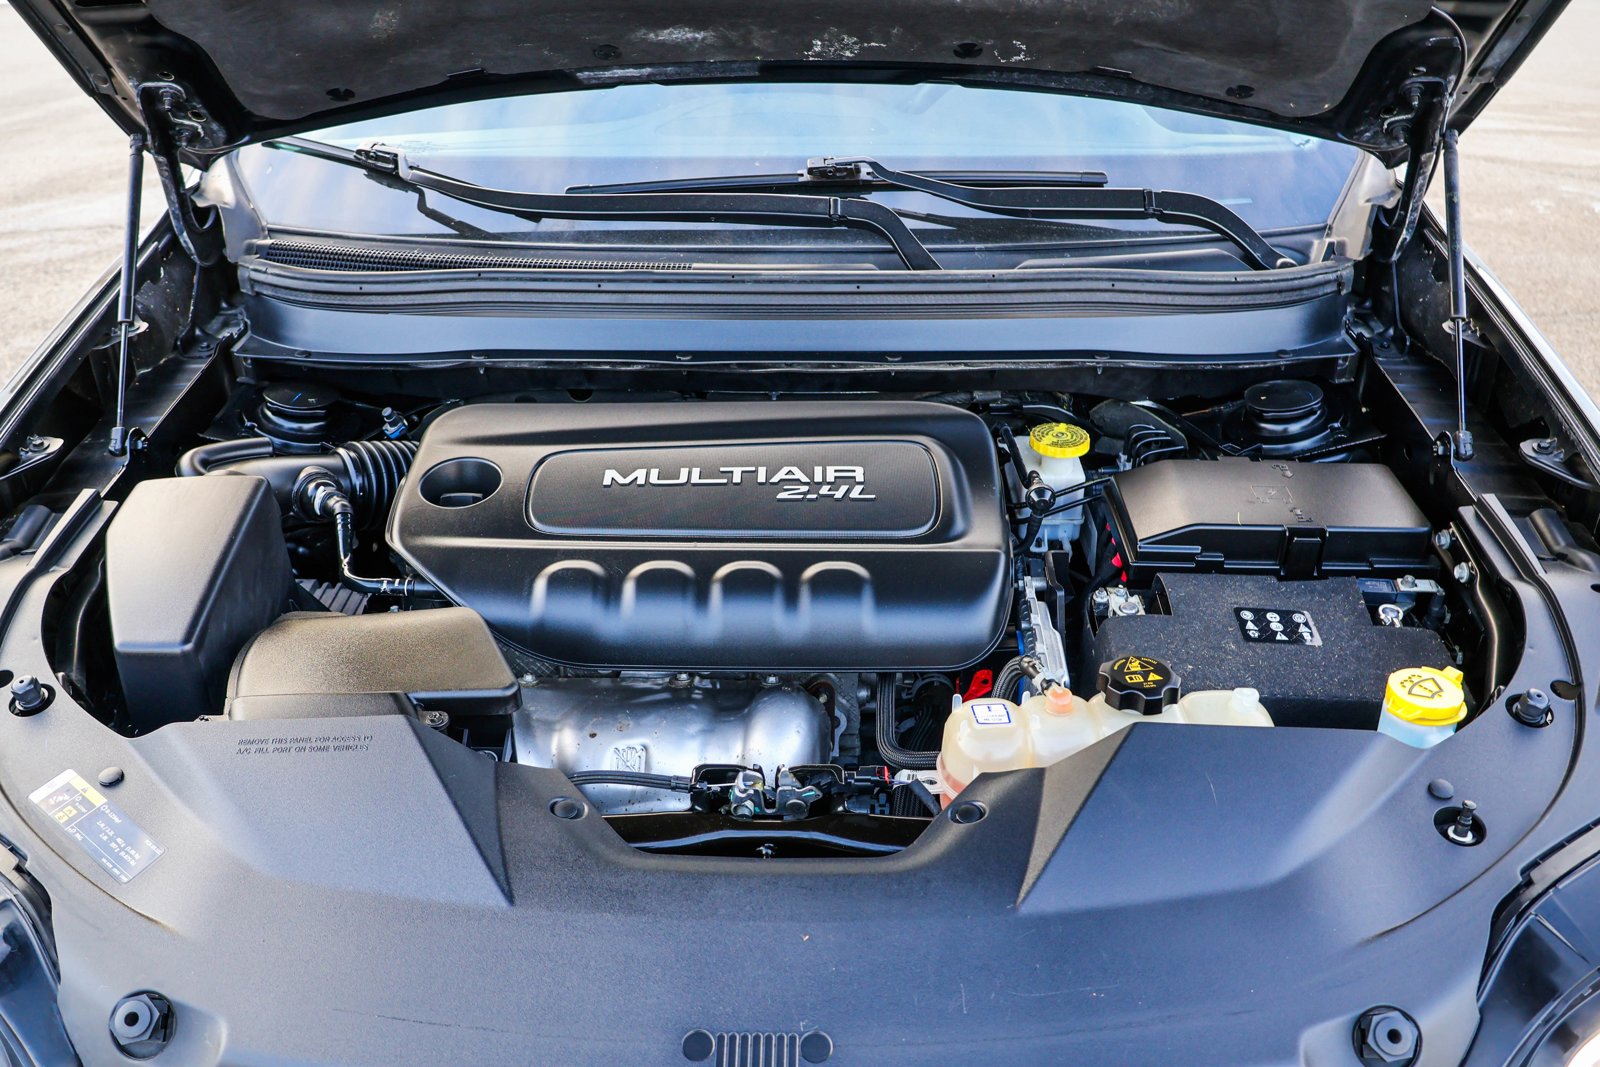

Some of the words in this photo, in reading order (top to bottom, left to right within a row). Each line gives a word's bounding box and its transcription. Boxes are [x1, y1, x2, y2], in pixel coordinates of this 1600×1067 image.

[602, 465, 865, 486] MULTIAIR
[776, 485, 876, 499] 2.4L
[238, 738, 269, 746] REMOVE
[271, 737, 288, 745] THIS
[289, 736, 312, 744] PANEL
[332, 744, 369, 752] VEHICLES
